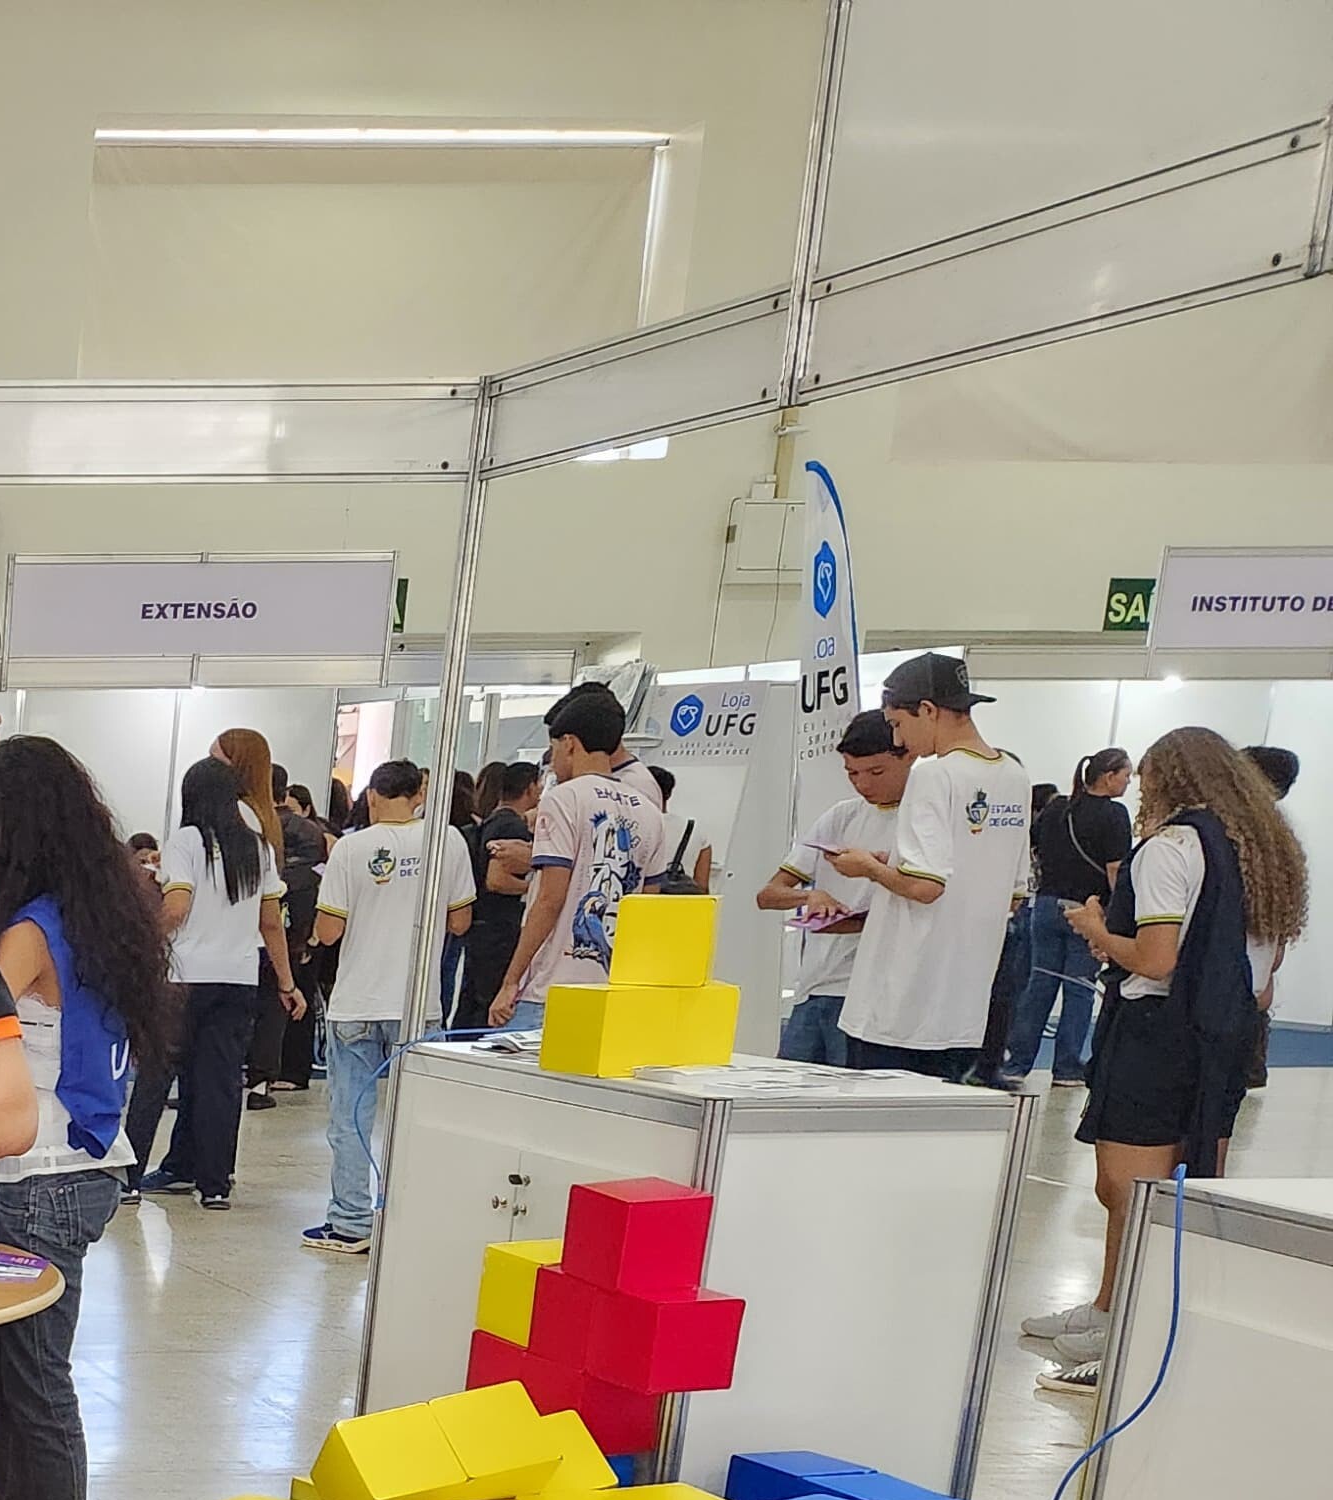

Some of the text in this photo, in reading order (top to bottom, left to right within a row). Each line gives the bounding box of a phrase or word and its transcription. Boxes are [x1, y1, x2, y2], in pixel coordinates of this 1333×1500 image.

[140, 598, 258, 620] EXTENSÃO
[1191, 595, 1305, 612] INSTITUTO
[721, 691, 751, 711] Loja
[801, 666, 849, 714] UFG
[705, 713, 757, 737] UFG
